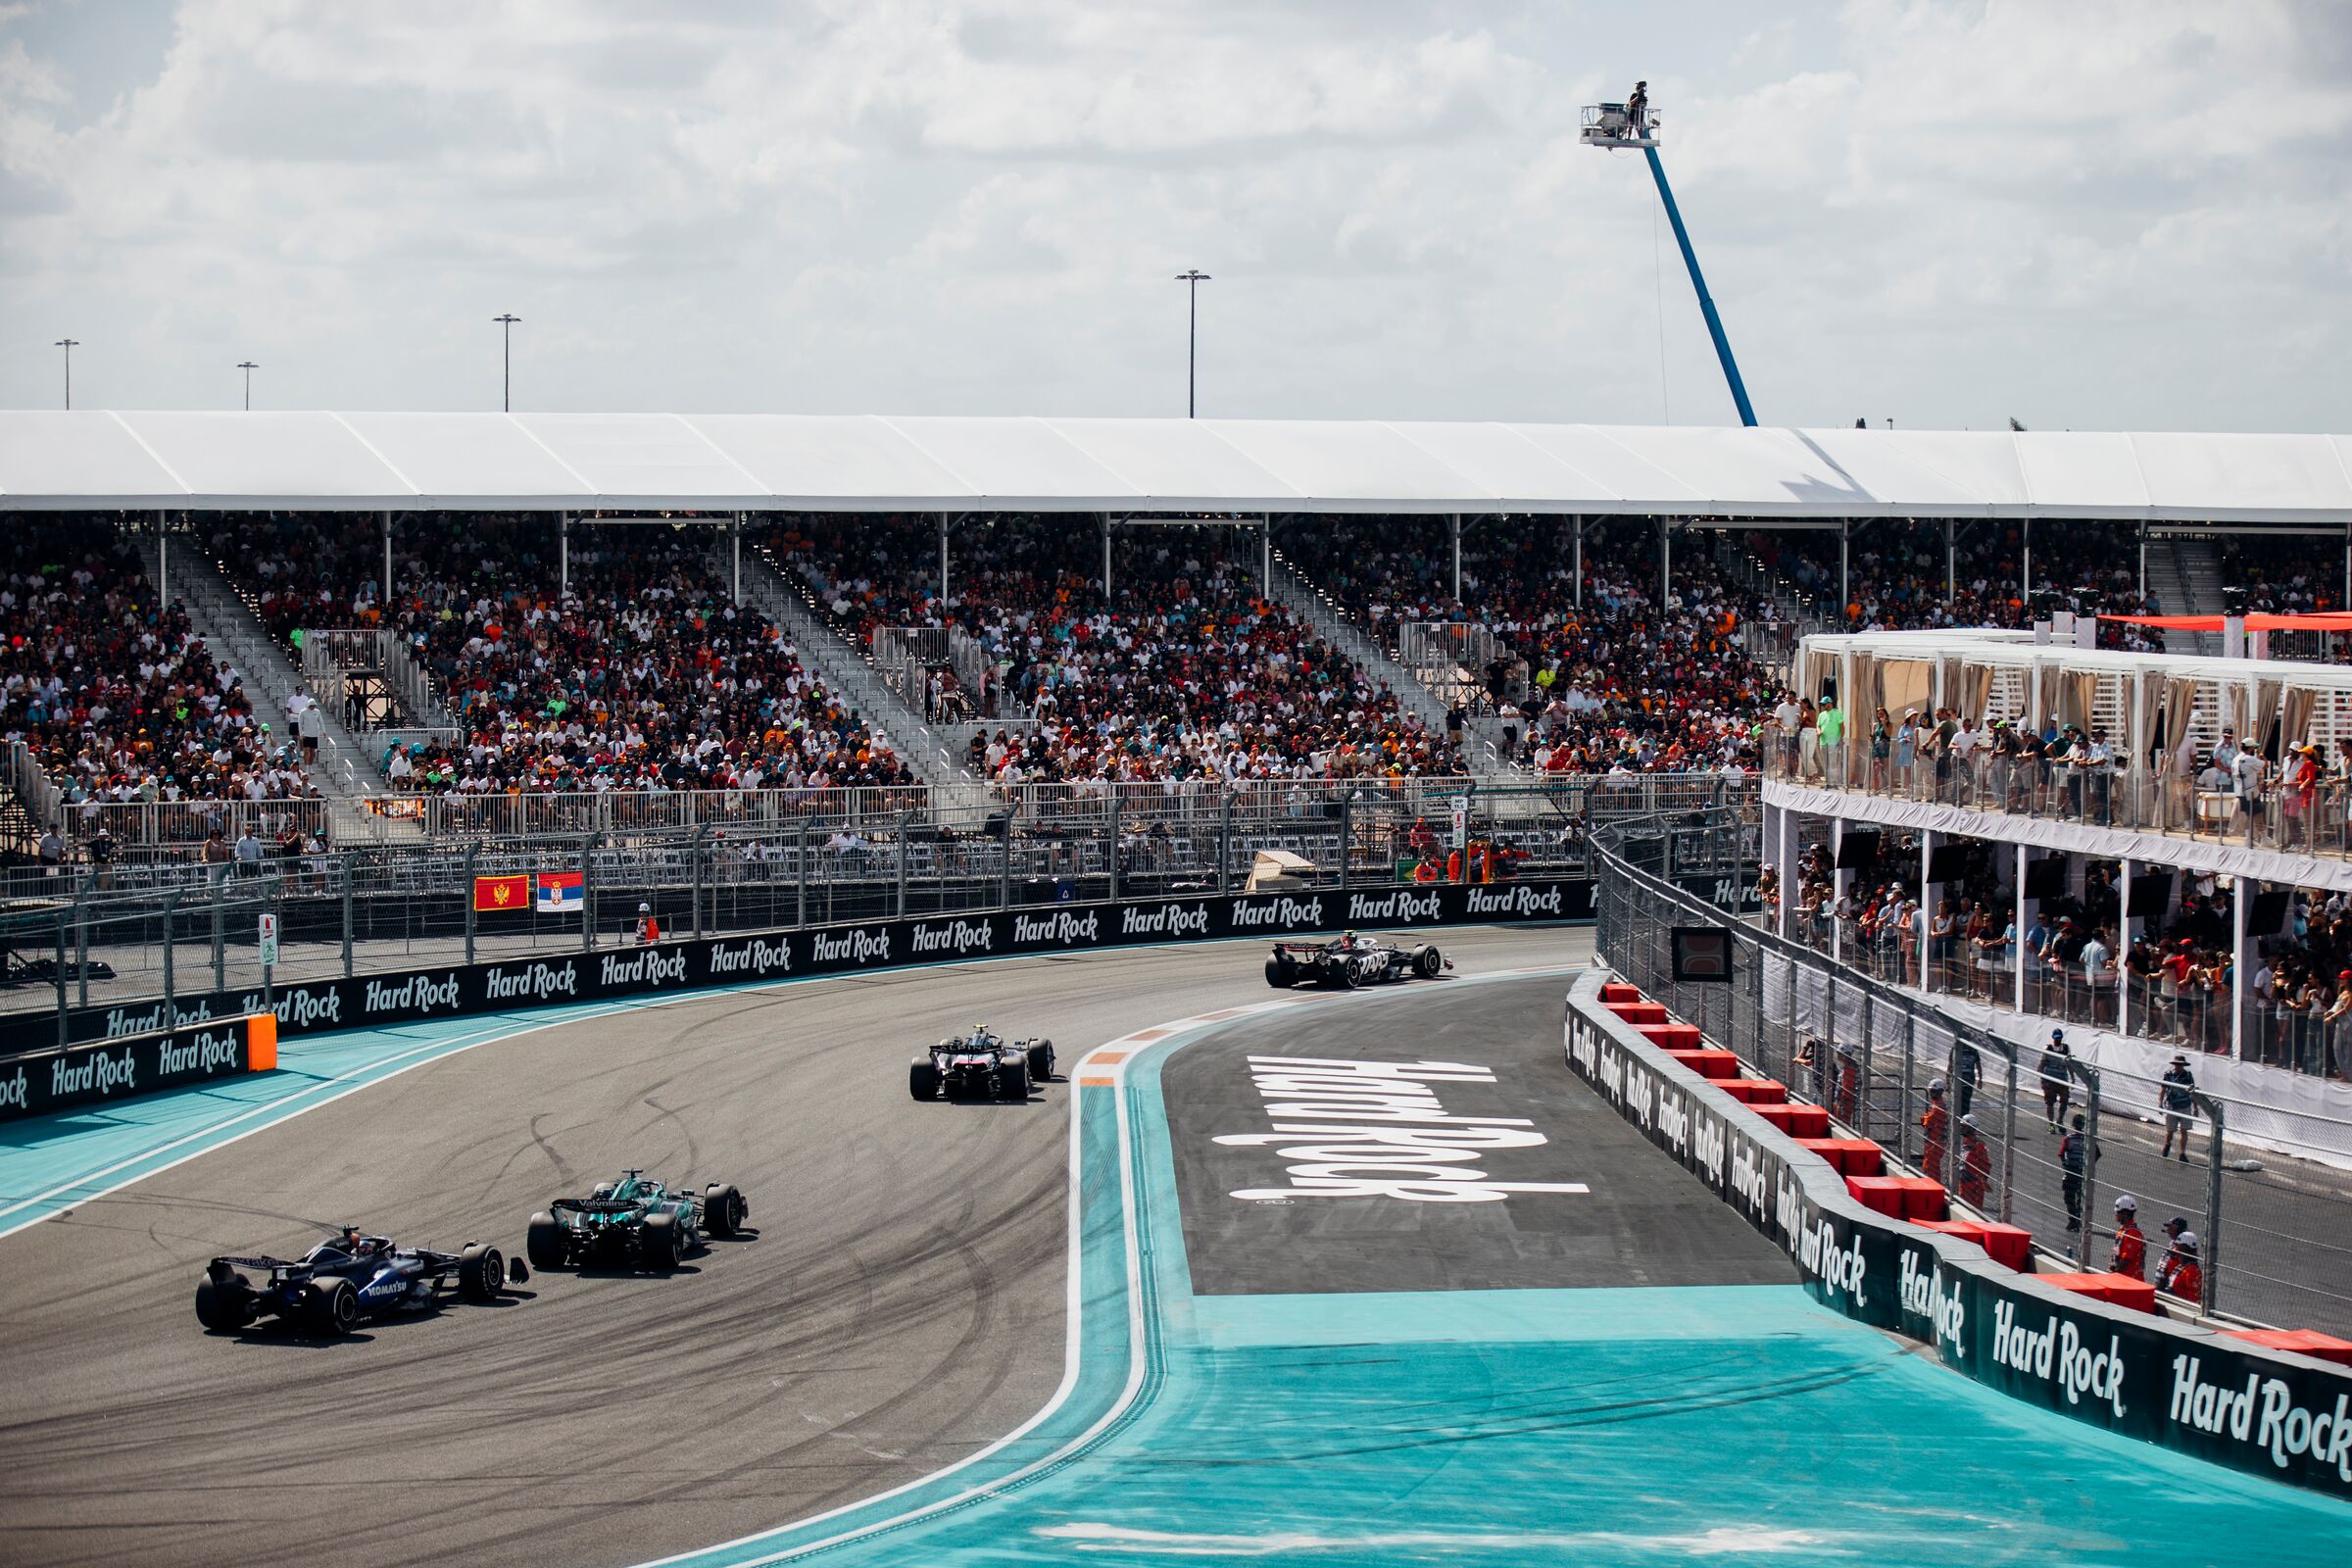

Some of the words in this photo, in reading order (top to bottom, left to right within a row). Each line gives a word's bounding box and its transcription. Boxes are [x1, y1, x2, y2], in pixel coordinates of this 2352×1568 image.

[1122, 905, 1166, 933] Hard
[1167, 903, 1207, 936] Rock
[1232, 898, 1278, 926] Hard
[1279, 896, 1323, 928] Rock
[1348, 892, 1397, 919] Hard
[1396, 890, 1441, 922] Rock
[1466, 887, 1516, 913] Hard
[1516, 885, 1561, 916] Rock
[813, 931, 853, 961] Hard
[853, 927, 890, 962] Rock
[912, 922, 954, 952] Hard
[955, 920, 992, 953] Rock
[1014, 912, 1057, 943] Hard
[1058, 909, 1098, 944] Rock
[601, 952, 645, 985] Hard
[646, 947, 687, 986] Rock
[710, 941, 752, 973] Hard
[753, 937, 791, 974] Rock
[365, 977, 414, 1012] Hard
[415, 972, 460, 1012] Rock
[486, 964, 532, 999] Hard
[534, 959, 576, 1000] Rock
[294, 986, 340, 1027] Rock
[160, 1034, 199, 1075] Hard
[200, 1028, 237, 1074] Rock
[51, 1054, 94, 1097] Hard
[95, 1047, 135, 1095] Rock
[1247, 1055, 1535, 1126] Hard
[1211, 1123, 1591, 1202] Rock
[578, 1199, 628, 1208] Valvoline
[1821, 1222, 1866, 1307] Rock
[368, 1281, 407, 1297] KOMATSU
[1934, 1267, 1965, 1358] Rock
[1992, 1298, 2058, 1380] Hard
[2058, 1320, 2126, 1418] Rock
[2170, 1353, 2261, 1442] Hard
[2258, 1378, 2352, 1483] Rock
